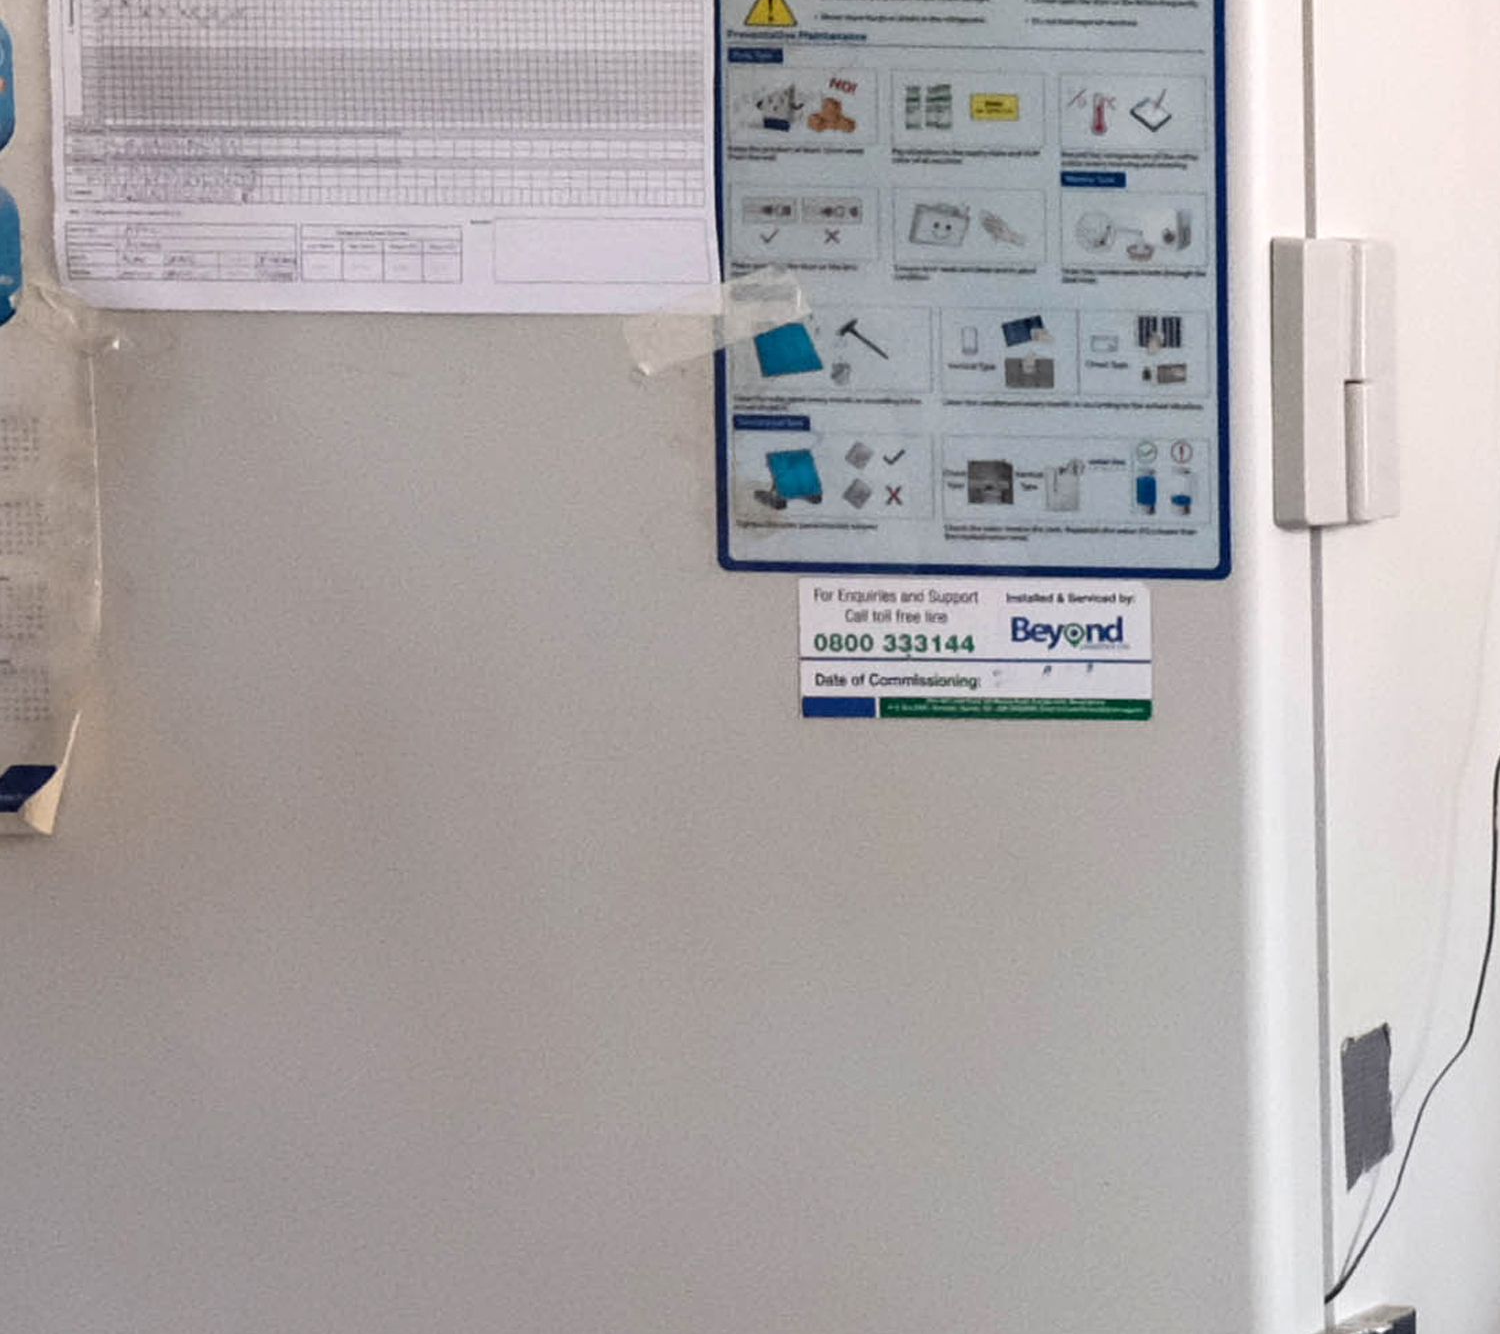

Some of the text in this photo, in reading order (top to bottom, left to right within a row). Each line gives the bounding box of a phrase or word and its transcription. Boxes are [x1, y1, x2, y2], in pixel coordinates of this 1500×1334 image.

[814, 588, 978, 605] For Enquiries and Support
[1011, 616, 1123, 649] Beyond
[814, 633, 975, 654] 0800 333144
[815, 672, 980, 691] Date of Commissioning:
